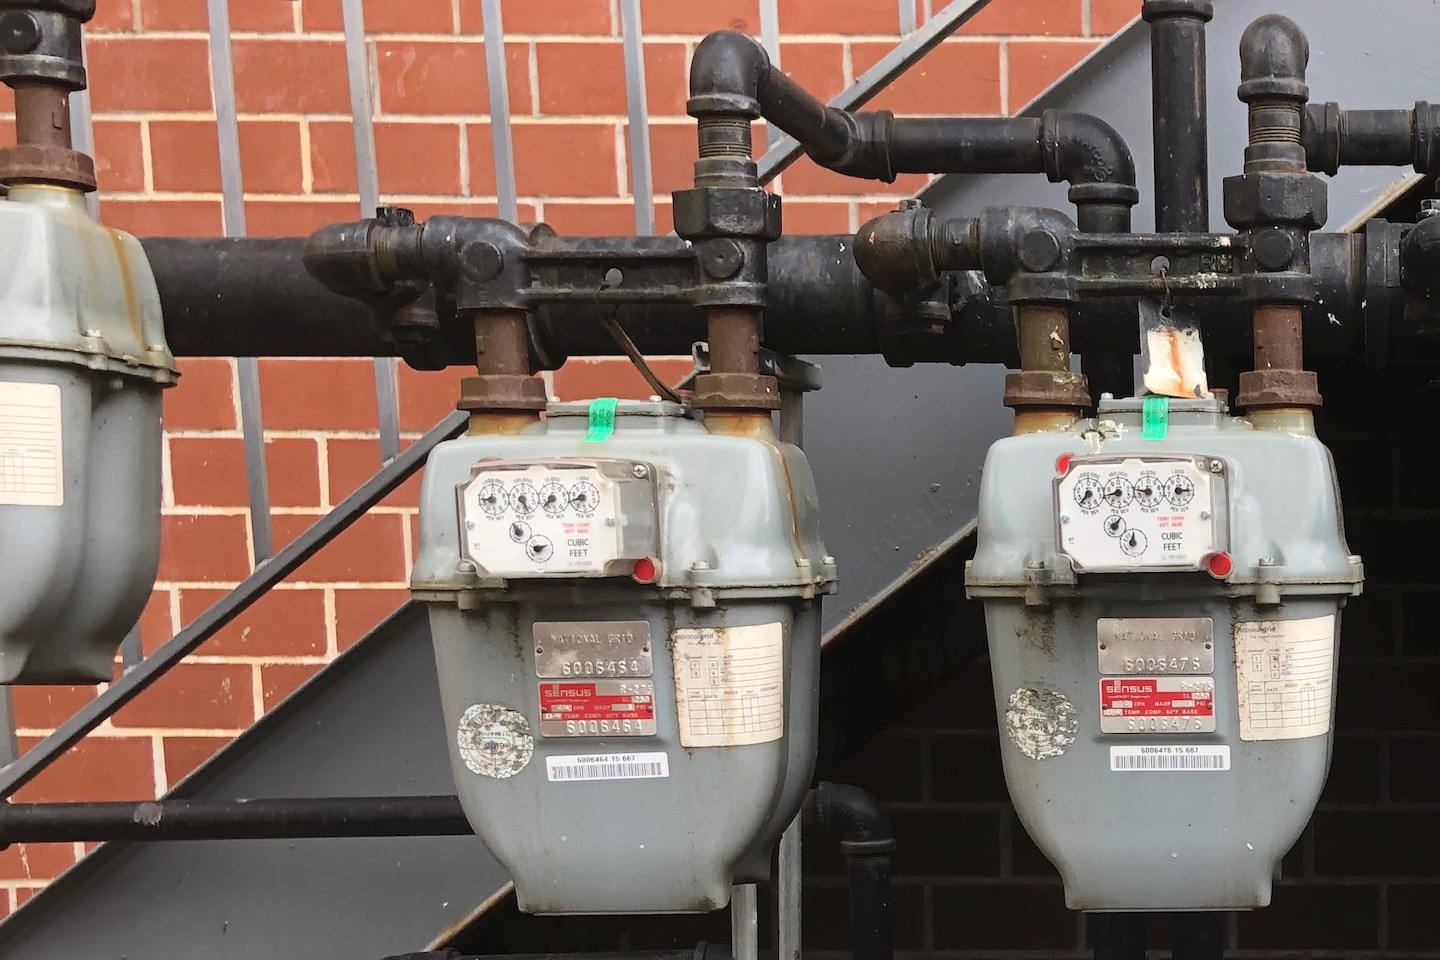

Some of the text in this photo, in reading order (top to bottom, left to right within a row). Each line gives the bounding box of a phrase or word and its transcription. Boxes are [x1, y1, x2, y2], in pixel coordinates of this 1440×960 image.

[1161, 532, 1183, 540] CUBIC
[567, 538, 590, 547] CUBIC
[1163, 543, 1182, 551] FEET
[569, 549, 588, 557] FEET
[1106, 685, 1152, 693] SENSUS
[545, 689, 591, 698] SENSUS
